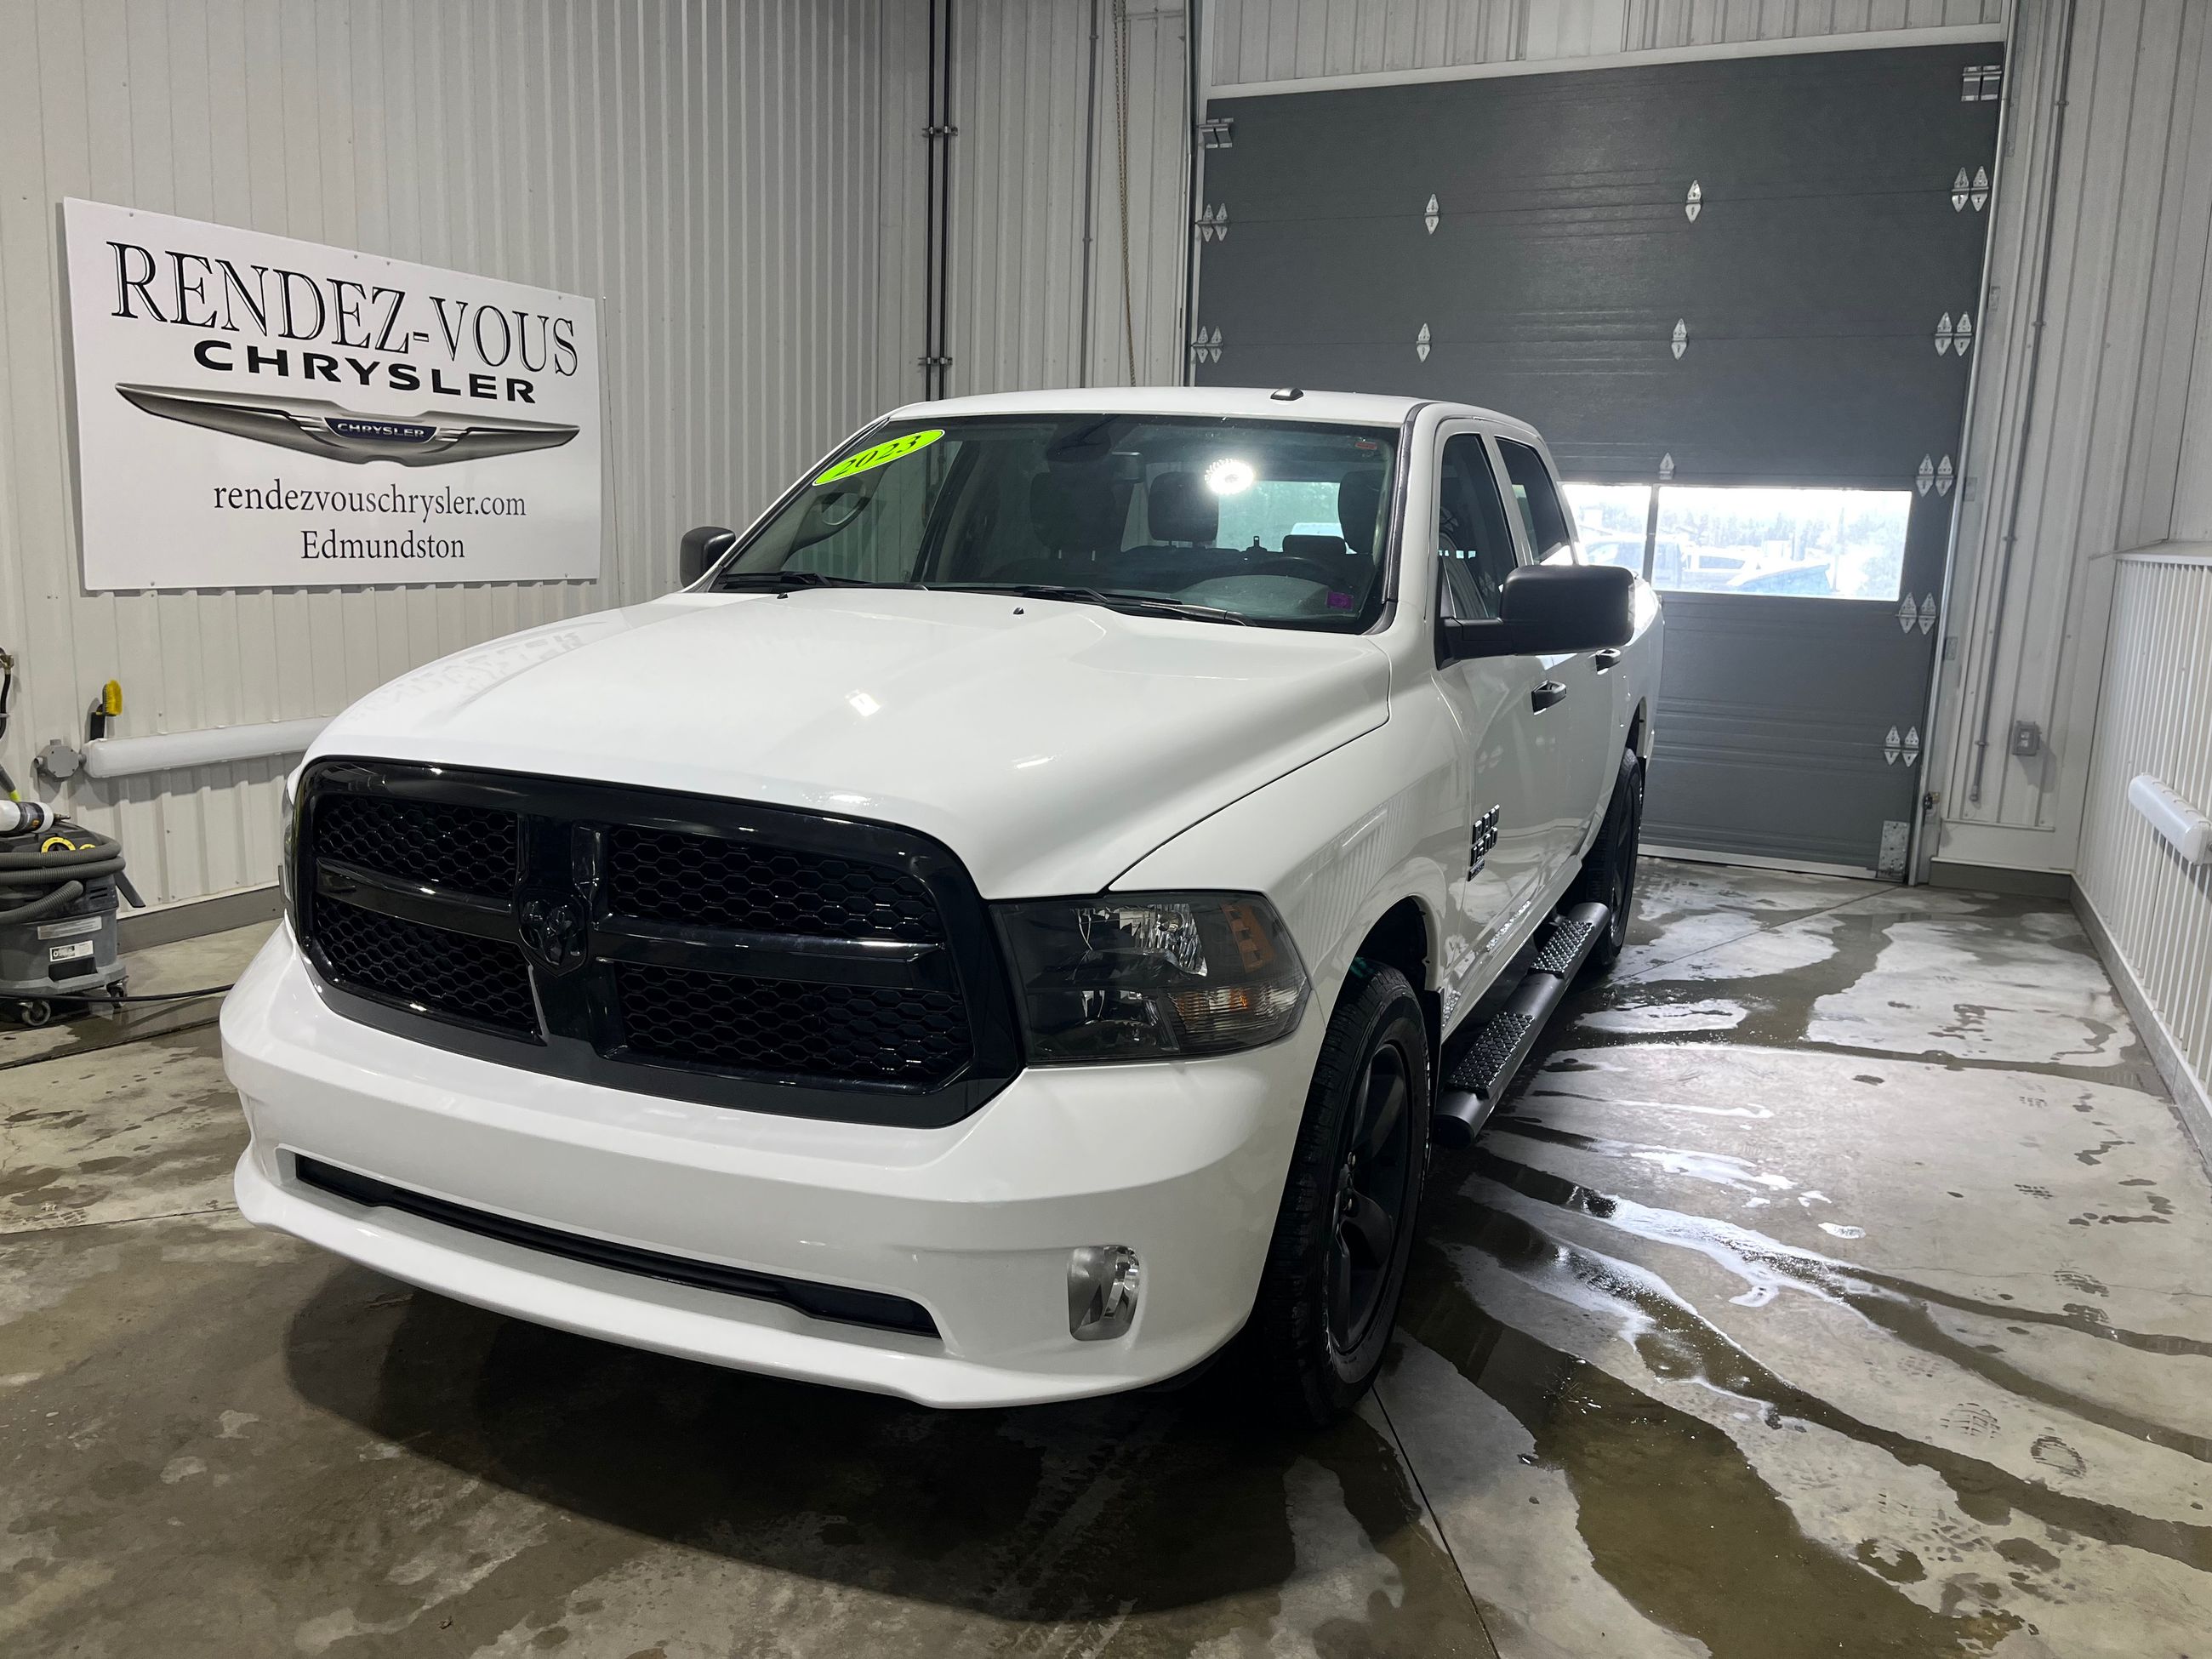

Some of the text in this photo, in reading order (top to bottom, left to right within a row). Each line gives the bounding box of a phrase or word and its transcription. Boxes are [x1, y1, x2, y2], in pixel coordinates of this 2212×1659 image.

[105, 241, 578, 377] RENDEZ-VOUS
[193, 339, 536, 404] CHRYSLER
[337, 423, 425, 438] CHRYSLER
[830, 435, 921, 478] 2023
[214, 478, 527, 523] rendezvouschrysler.com
[300, 528, 465, 559] Edmundston
